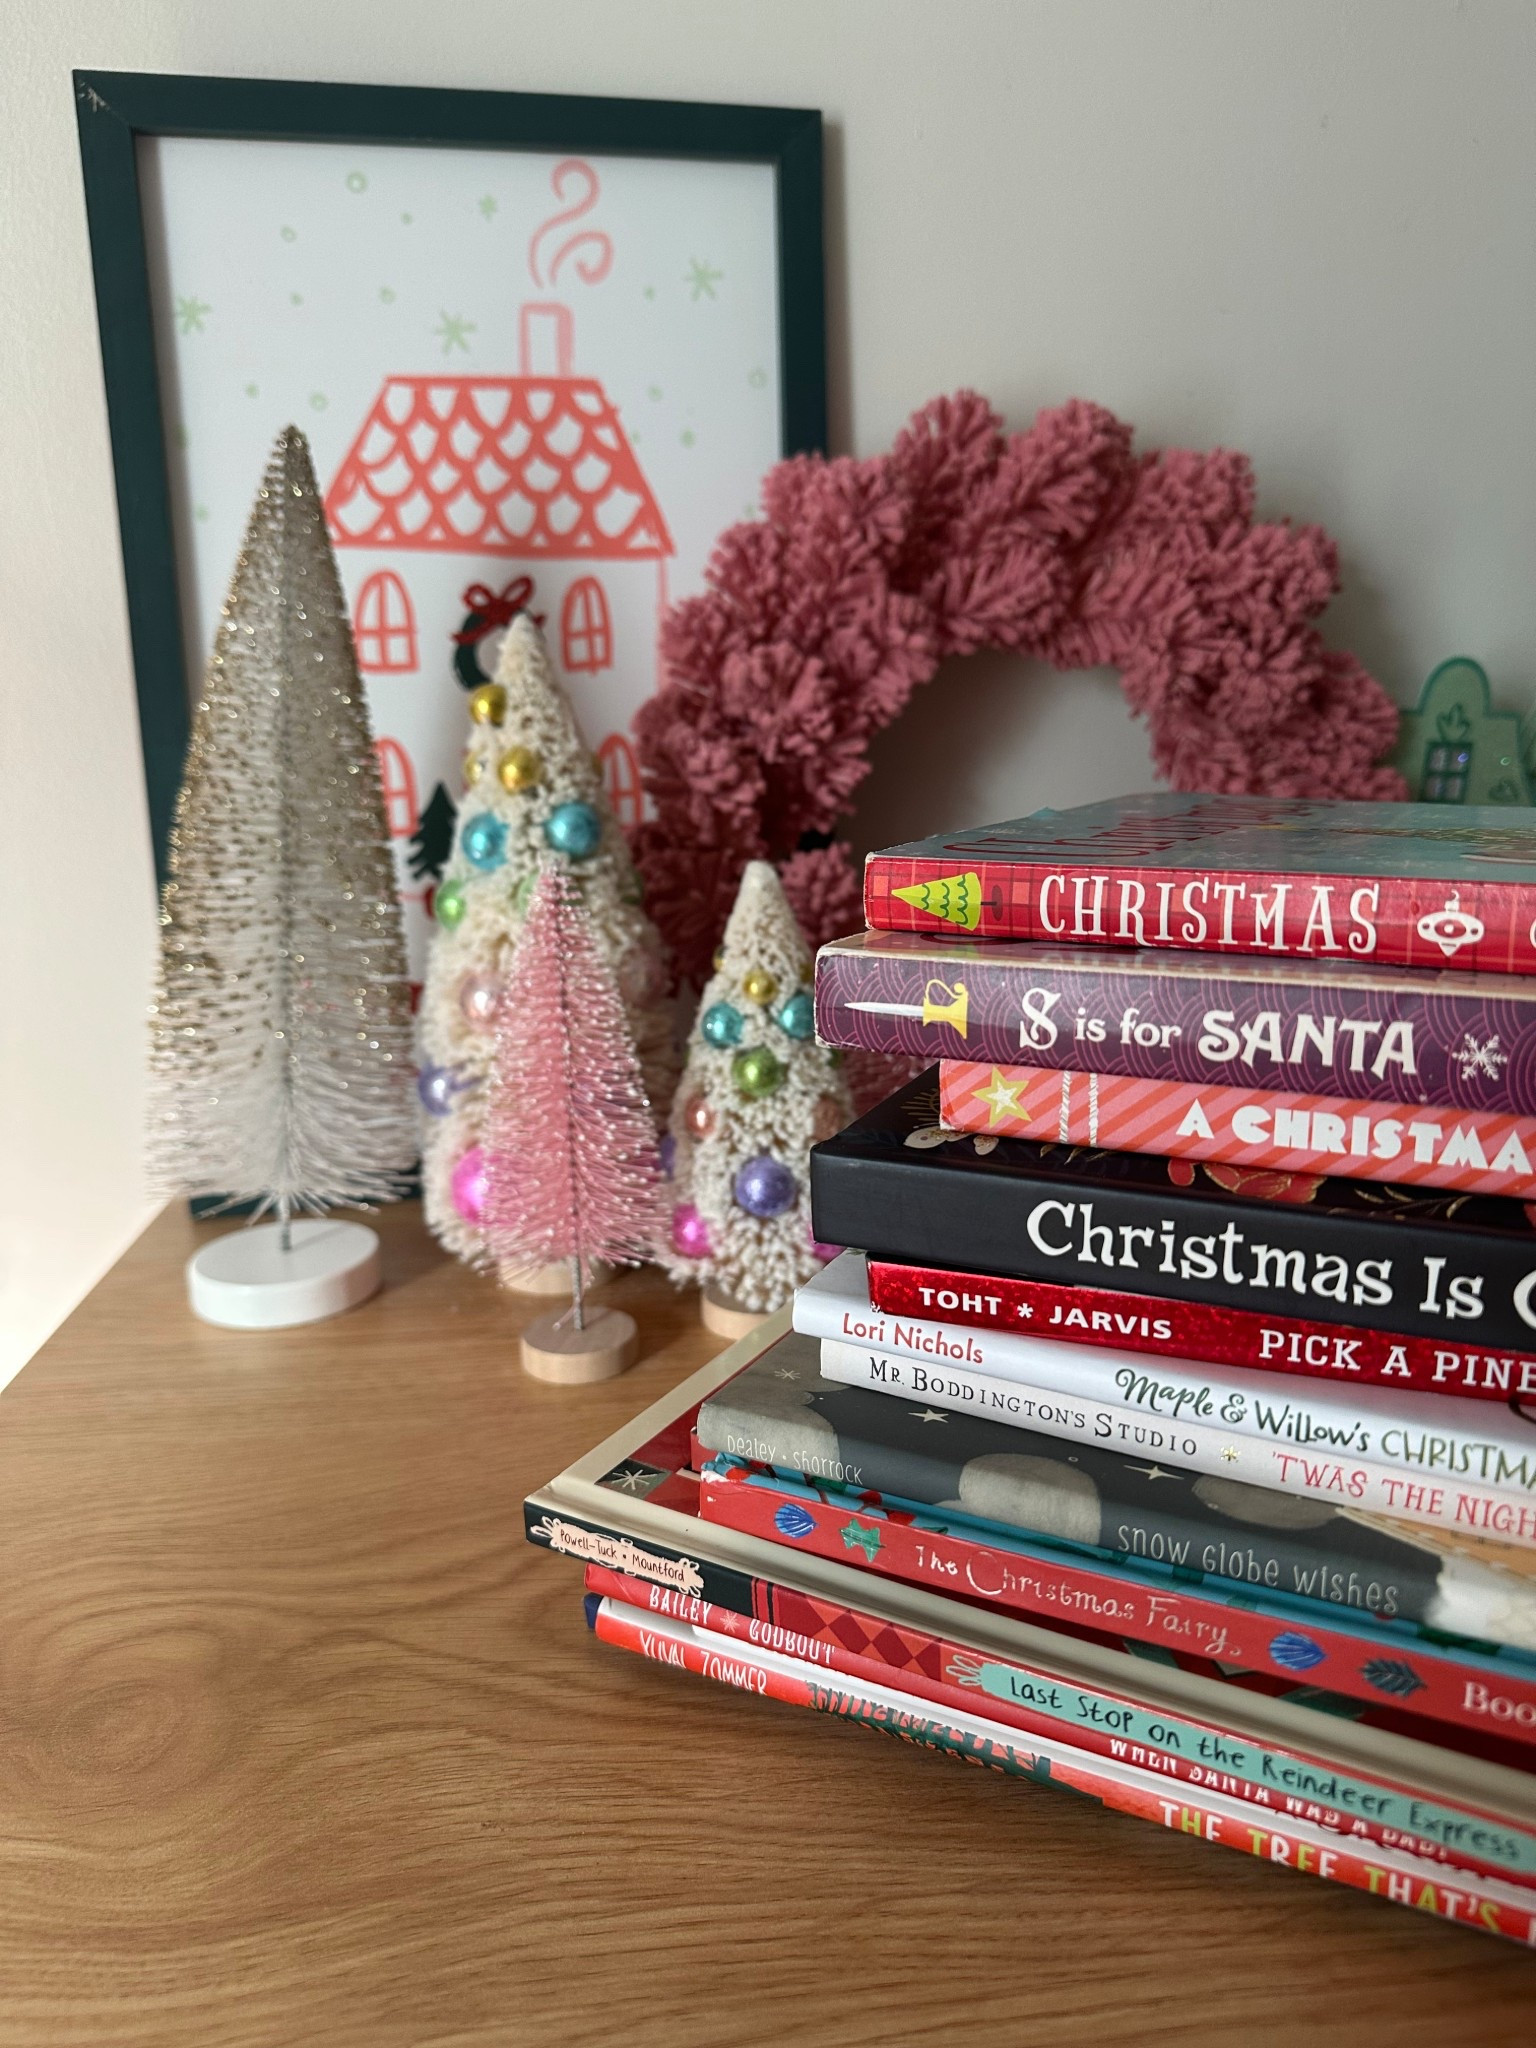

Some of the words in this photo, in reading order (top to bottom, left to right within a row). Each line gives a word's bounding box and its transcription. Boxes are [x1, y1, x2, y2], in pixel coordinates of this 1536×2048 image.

[1038, 874, 1379, 954] CHRISTMAS
[1019, 986, 1062, 1051] S
[1075, 1007, 1106, 1042] is
[1120, 1007, 1182, 1049] for
[1197, 1009, 1418, 1080] SANTA
[1175, 1097, 1215, 1140] A
[1231, 1104, 1534, 1176] CHRISTMA
[1026, 1199, 1394, 1308] Christmas
[1418, 1255, 1485, 1320] Is
[843, 1312, 886, 1343] Lori
[894, 1322, 984, 1365] Nichols
[918, 1286, 1002, 1316] TOHT
[1049, 1305, 1173, 1340] JARVIS
[1258, 1328, 1362, 1373] PICK
[1380, 1344, 1412, 1378] A
[1431, 1350, 1536, 1395] PINE
[1115, 1368, 1214, 1418] Maple
[1220, 1392, 1247, 1424] &
[1254, 1399, 1371, 1452] Willow's
[1381, 1478, 1445, 1516] THE
[915, 1545, 959, 1576] The
[966, 1550, 1135, 1621] Christmas
[649, 1584, 714, 1626] BAILEY
[749, 1618, 836, 1665] GODBOUT
[1010, 1675, 1063, 1710] Last
[1148, 1723, 1181, 1749] on
[1197, 1737, 1246, 1769] the
[1261, 1752, 1393, 1815] Reindeer
[1409, 1801, 1521, 1860] Express
[1158, 1800, 1224, 1841] THE
[1247, 1827, 1339, 1879] TREE
[1363, 1864, 1501, 1935] THAT'S
